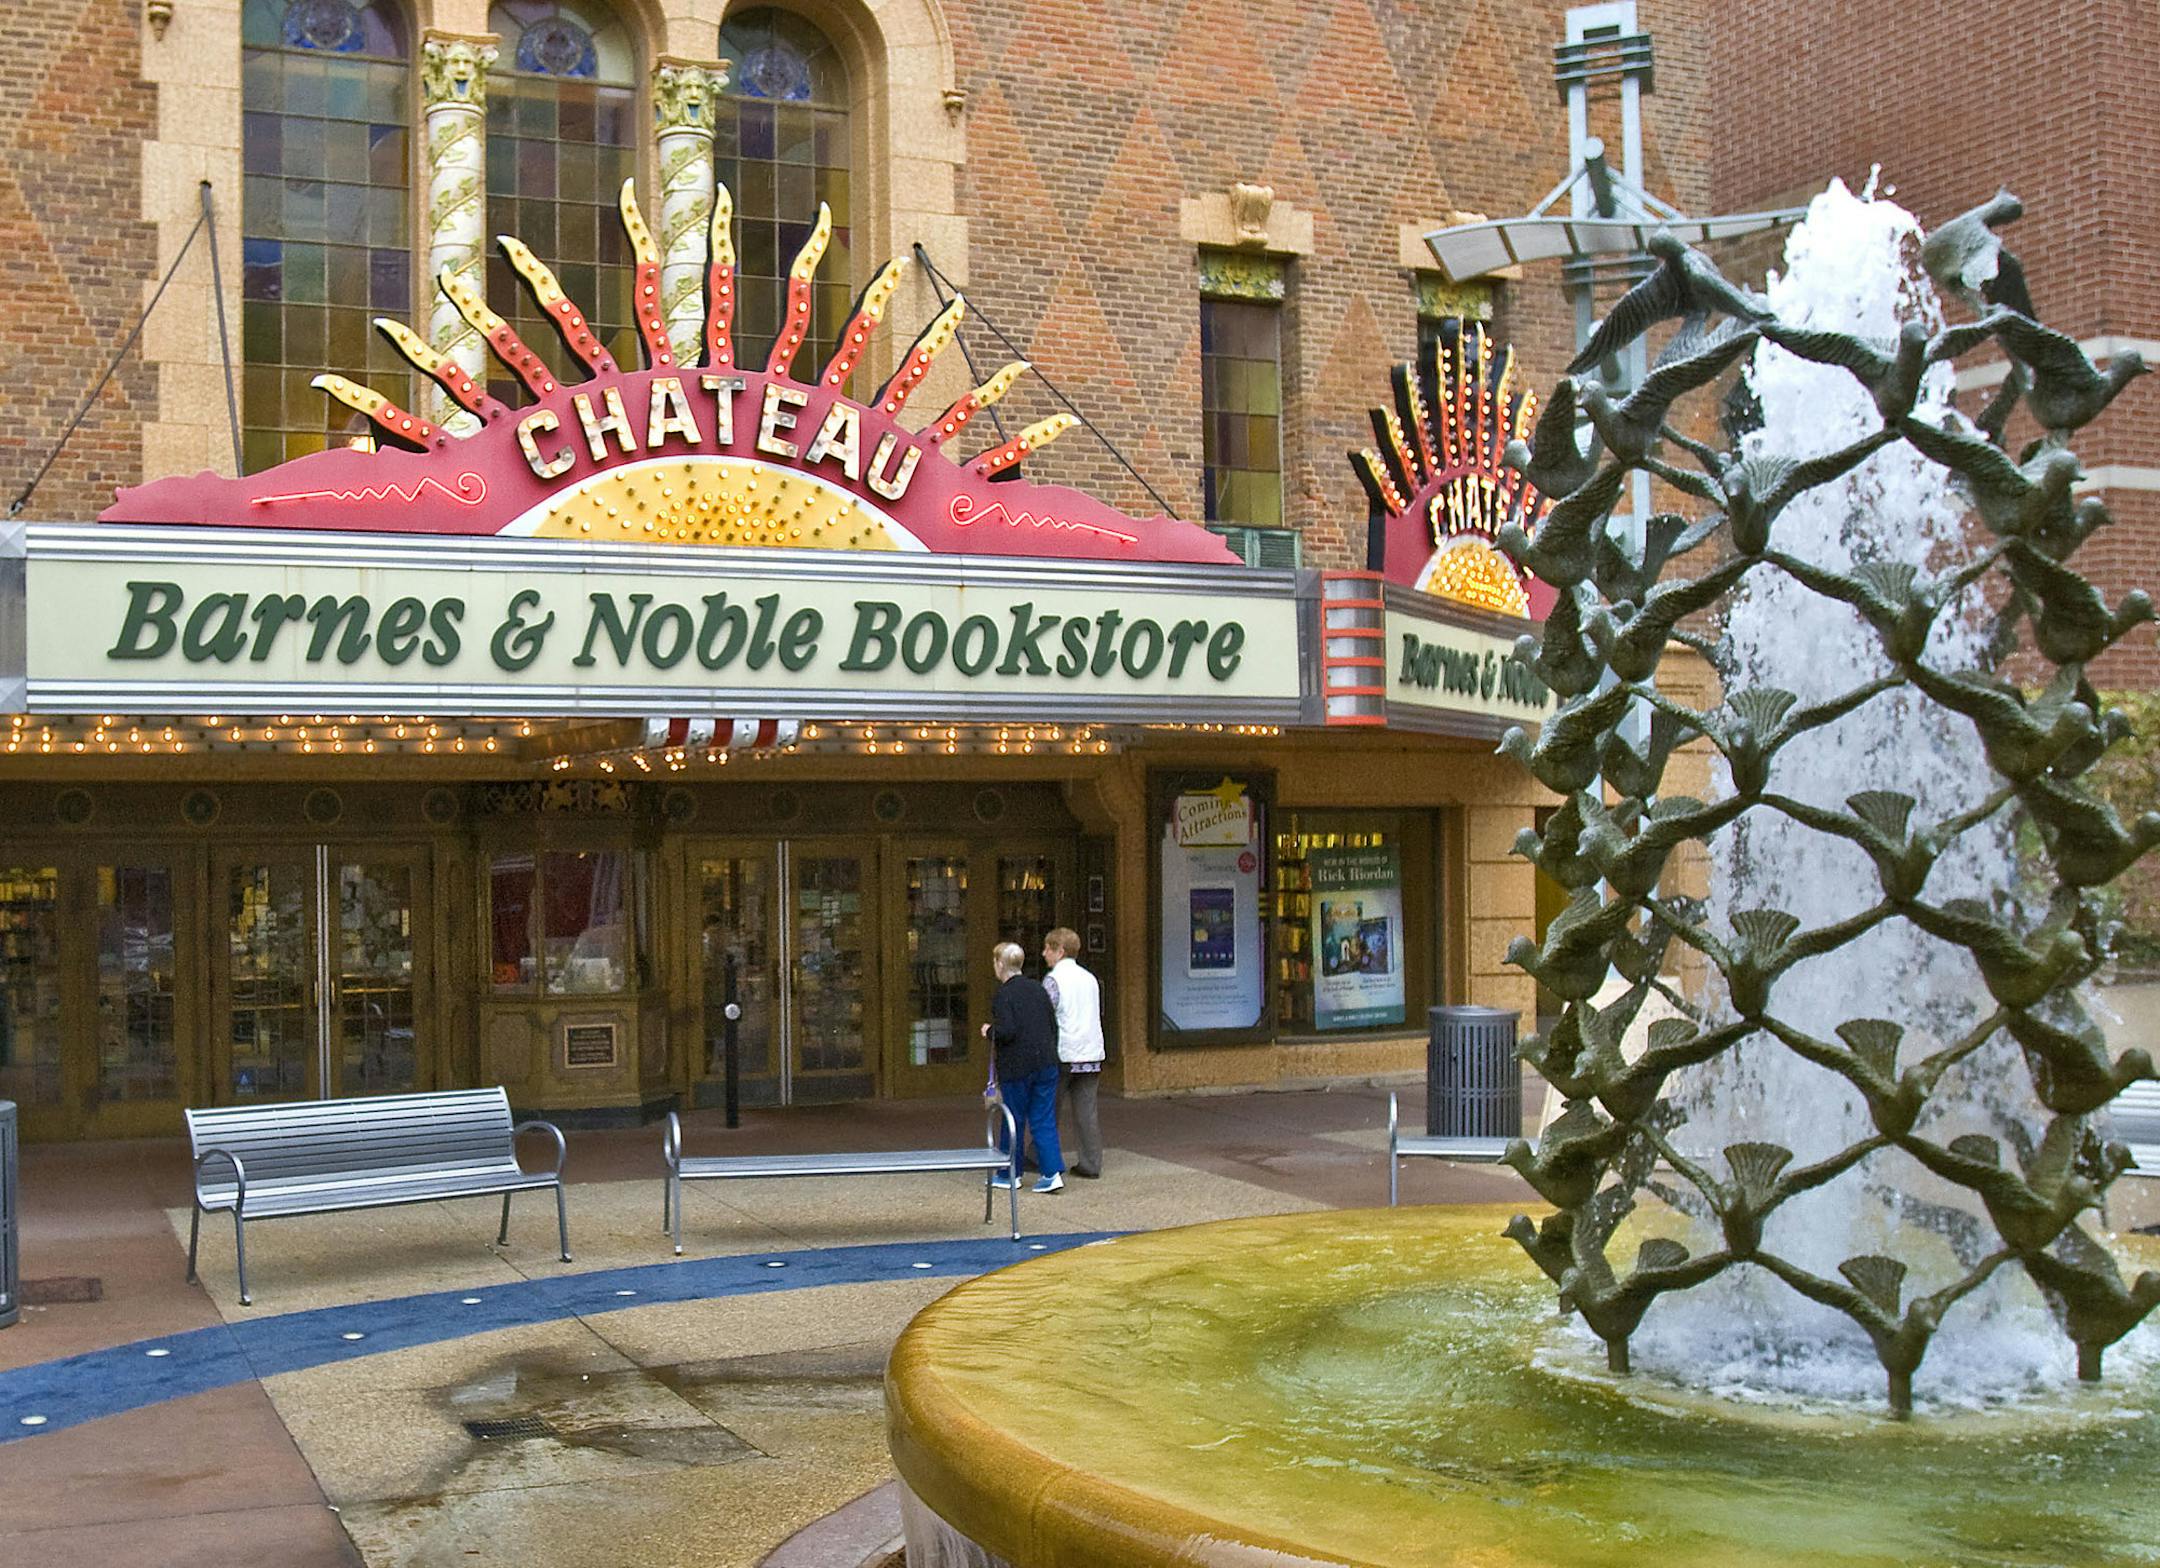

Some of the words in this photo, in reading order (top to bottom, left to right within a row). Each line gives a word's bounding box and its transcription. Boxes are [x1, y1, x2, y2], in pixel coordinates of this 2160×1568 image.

[516, 374, 922, 501] CHATEAU
[107, 581, 467, 669] Barnes
[490, 589, 555, 674] &
[572, 592, 824, 675] Noble
[838, 600, 1245, 682] Bookstore
[1399, 632, 1480, 698] Barnes
[1318, 868, 1346, 882] Rick
[1350, 867, 1394, 881] Riordan
